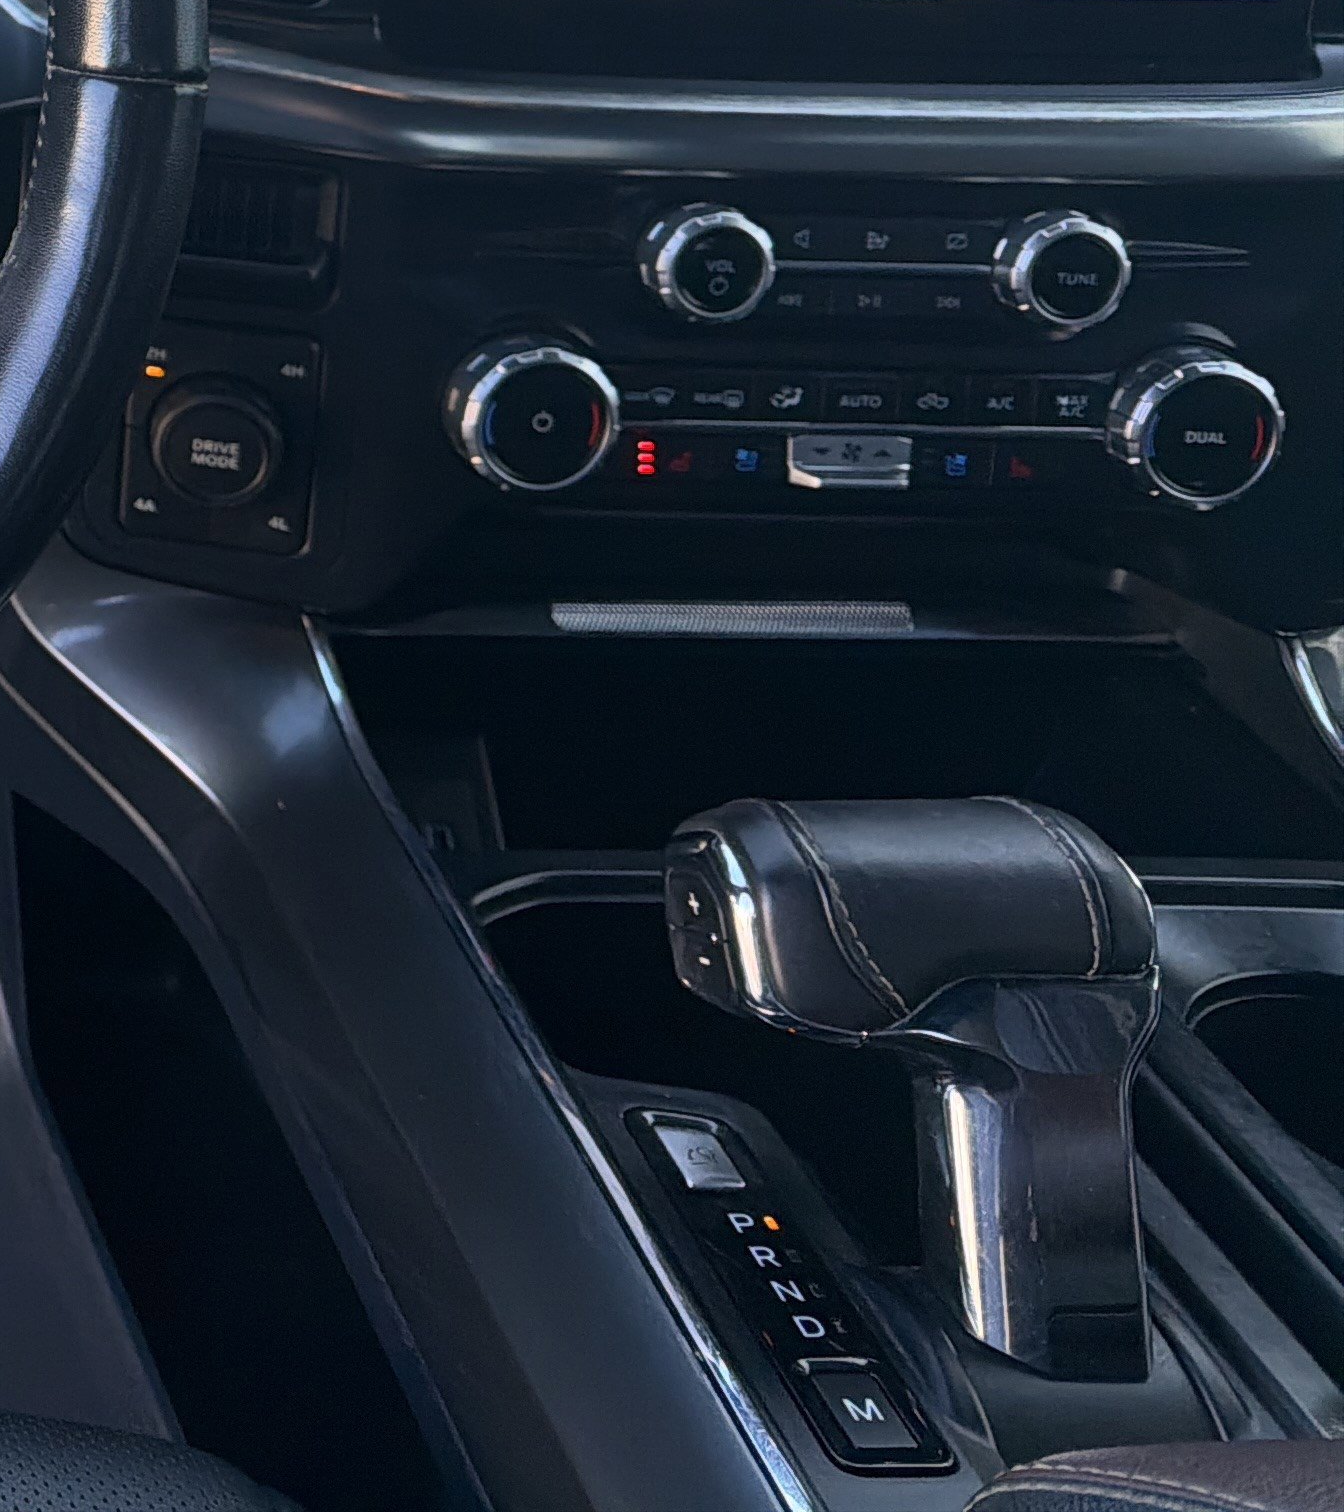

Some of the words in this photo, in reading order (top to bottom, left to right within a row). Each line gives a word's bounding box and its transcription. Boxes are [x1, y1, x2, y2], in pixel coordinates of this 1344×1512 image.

[1057, 272, 1099, 286] TUNE
[280, 364, 305, 378] 4H
[839, 395, 882, 408] AUTO
[191, 438, 241, 455] DRIVE
[1185, 431, 1227, 445] DUAL
[190, 452, 240, 471] MODE
[726, 1212, 754, 1234] P
[748, 1245, 783, 1268] R
[769, 1279, 805, 1302] N
[792, 1315, 826, 1338] D
[841, 1397, 885, 1422] M
